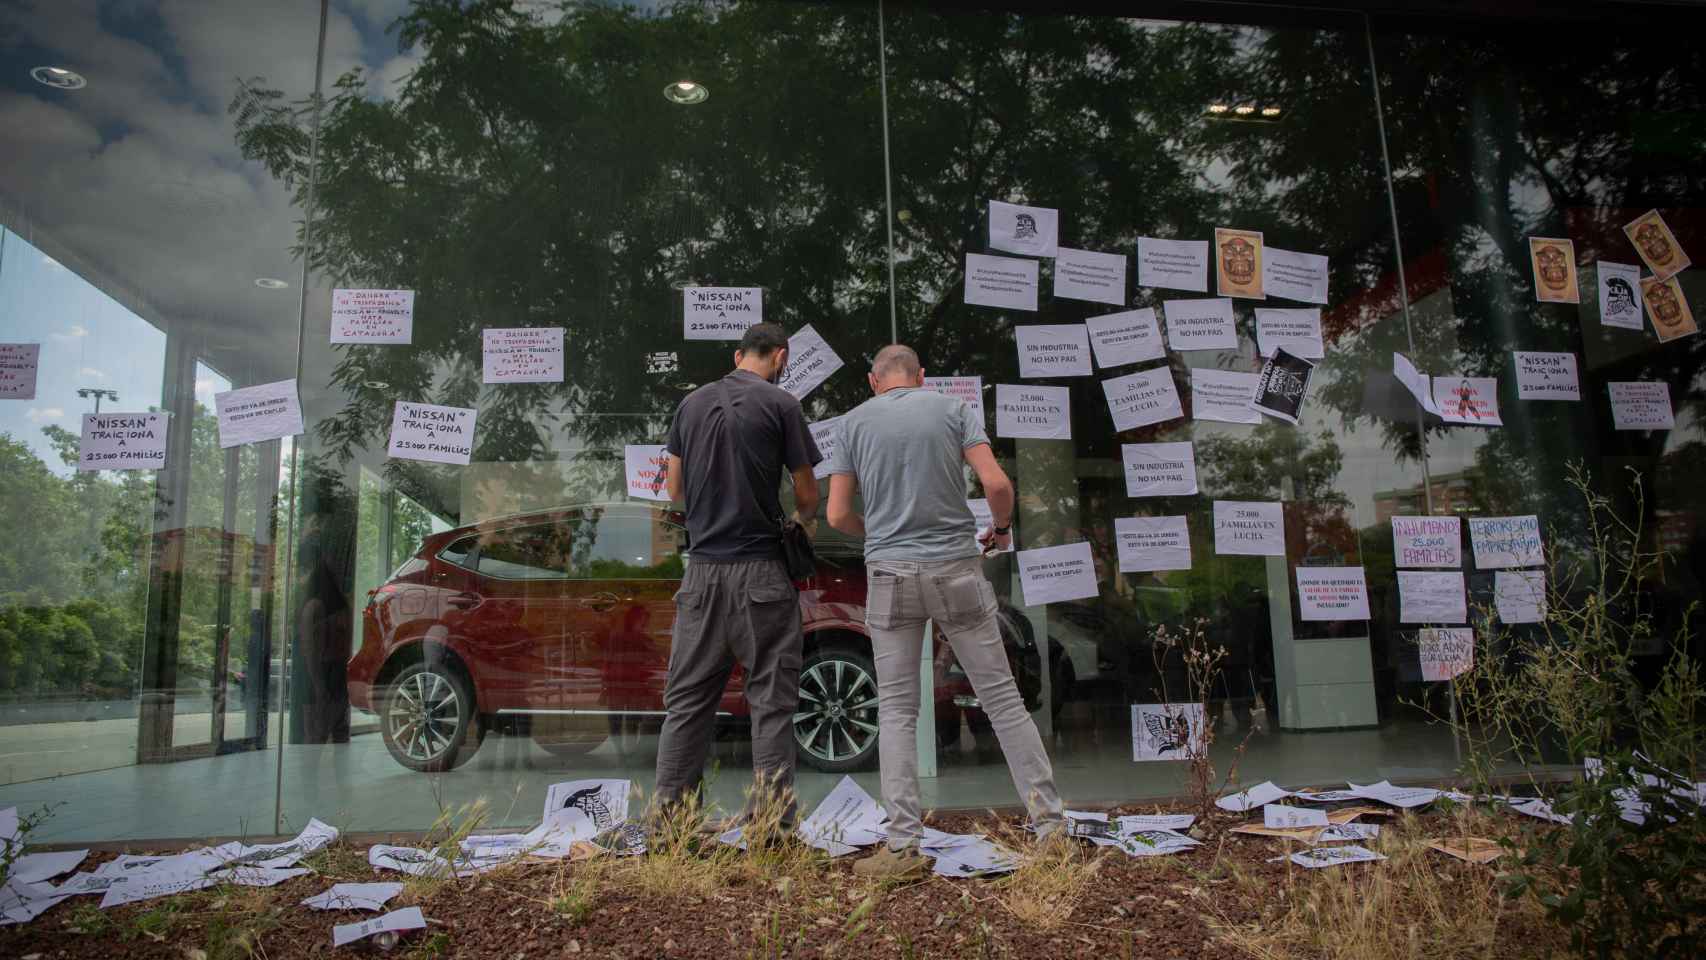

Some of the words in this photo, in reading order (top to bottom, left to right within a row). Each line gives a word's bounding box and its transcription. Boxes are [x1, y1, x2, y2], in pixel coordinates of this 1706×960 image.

[1040, 343, 1080, 352] INDUSTRIA
[1044, 355, 1059, 364] HAY
[1113, 391, 1155, 406] FAMILIAS
[1004, 403, 1048, 413] FAMILIAS
[1129, 401, 1160, 413] LUCHA
[1017, 415, 1048, 424] LUCHA
[1146, 462, 1185, 472] INDUSTRIA
[1233, 532, 1264, 541] LUCHA
